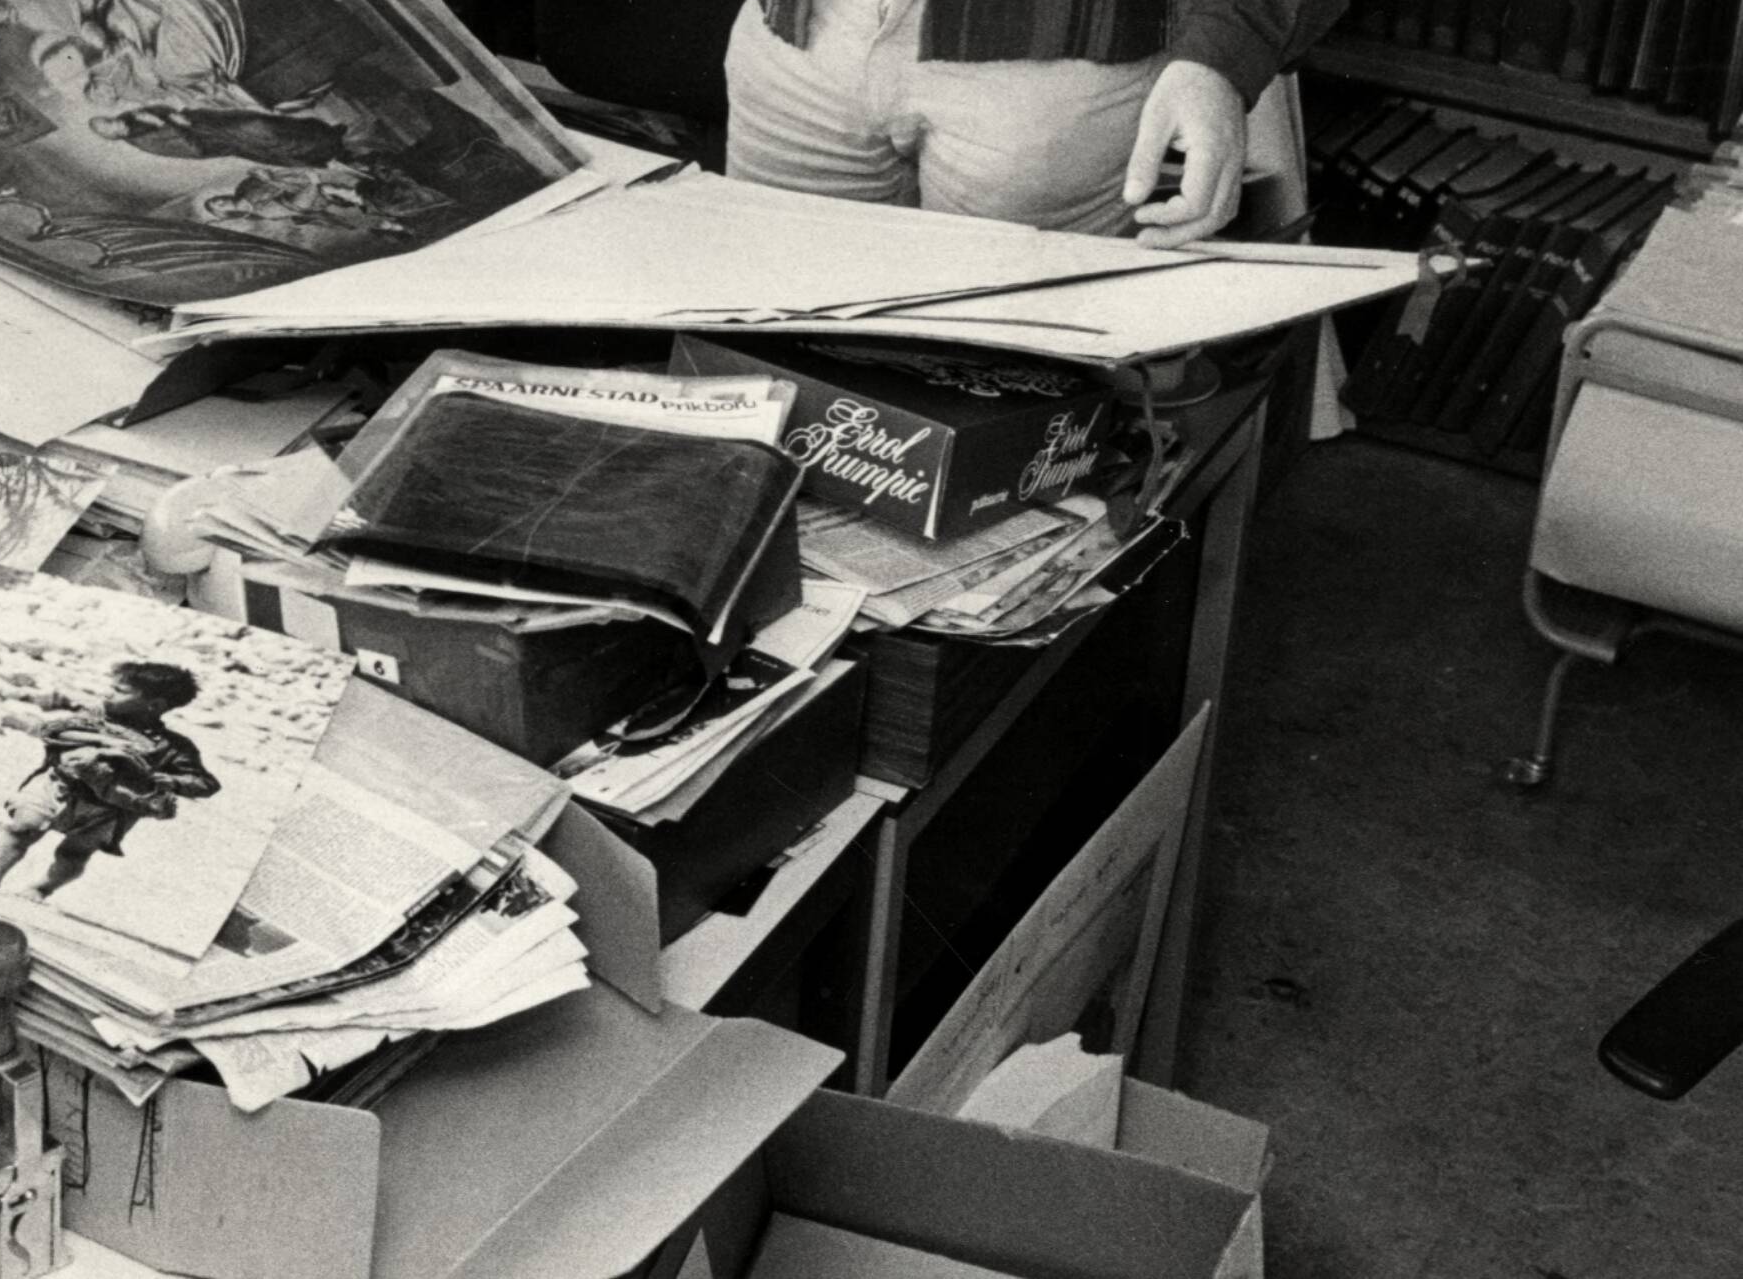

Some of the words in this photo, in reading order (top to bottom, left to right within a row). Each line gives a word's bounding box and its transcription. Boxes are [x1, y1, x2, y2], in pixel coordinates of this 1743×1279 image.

[454, 377, 659, 404] SPAARNESTAD
[826, 398, 932, 464] Errol
[1044, 403, 1103, 462] Errol
[783, 422, 931, 505] Trumpie
[373, 659, 385, 676] 6
